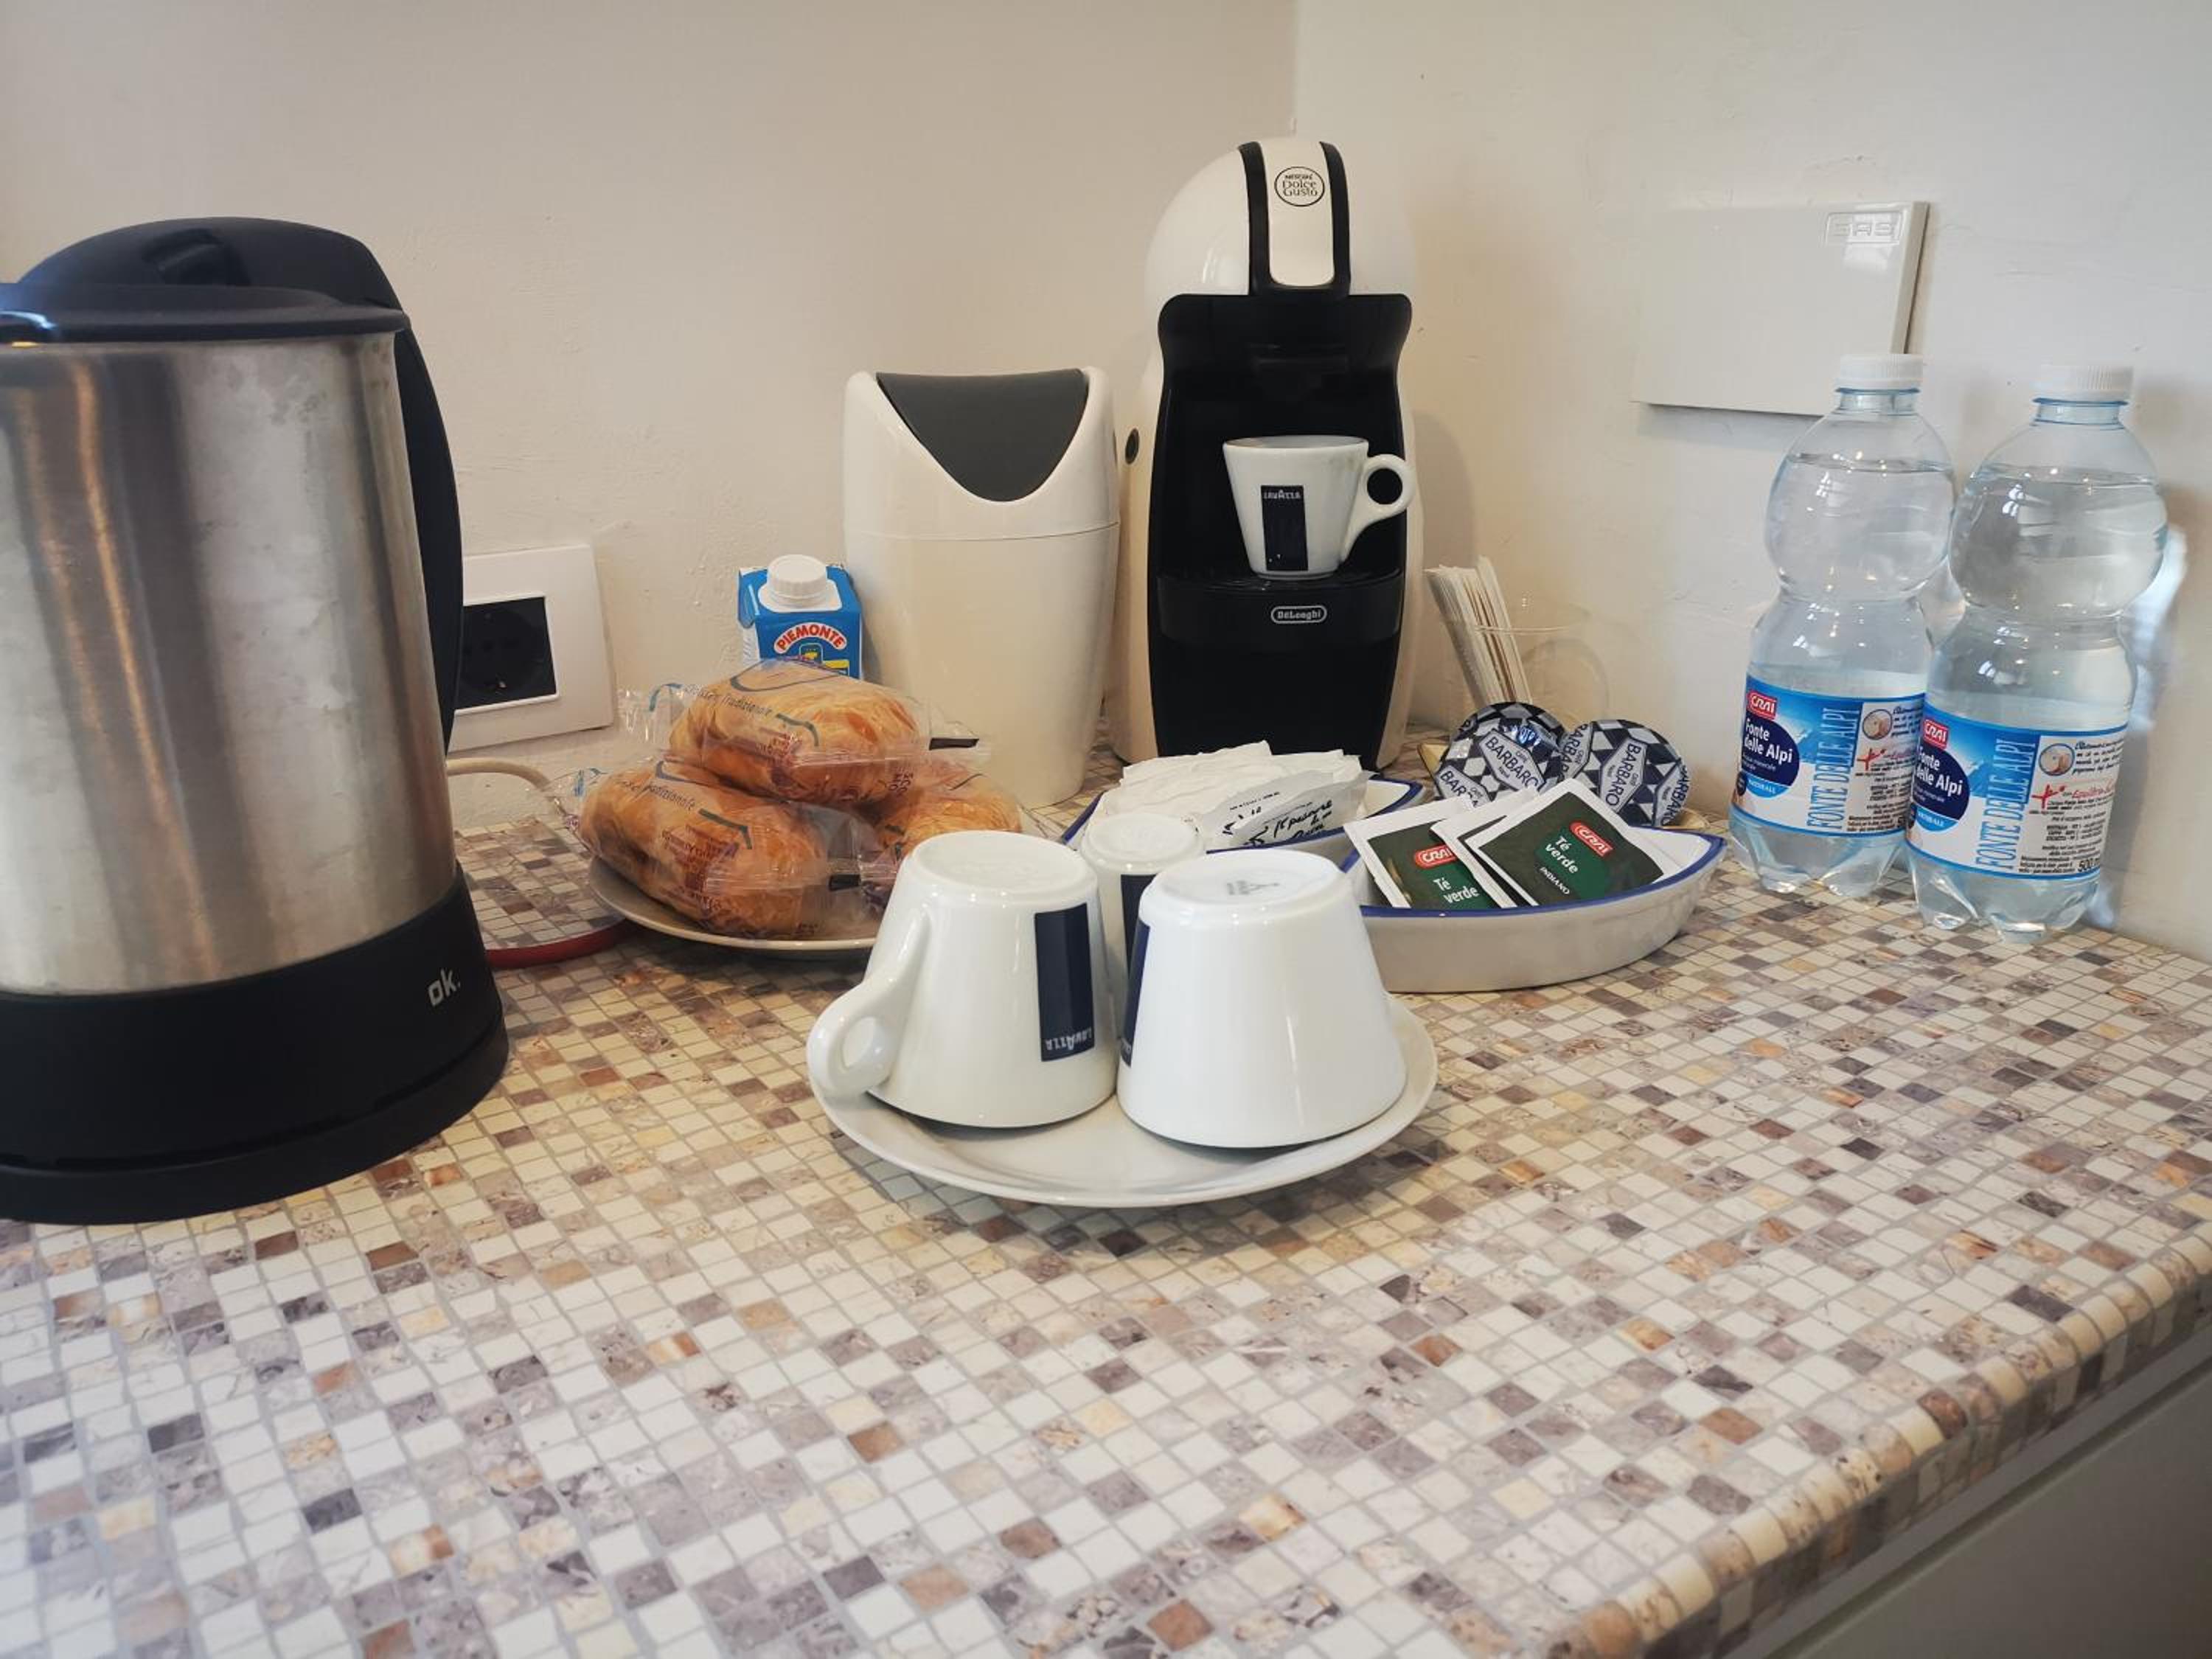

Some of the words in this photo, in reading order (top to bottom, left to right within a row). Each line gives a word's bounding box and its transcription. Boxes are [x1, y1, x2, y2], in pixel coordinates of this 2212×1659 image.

[1282, 178, 1316, 189] Dolce
[1282, 187, 1318, 196] Gusto
[1263, 490, 1301, 499] LAVAZZA
[776, 624, 846, 651] PIEMONTE
[1750, 693, 1775, 714] CRAI
[1820, 707, 1861, 740] ALPI
[1924, 722, 1947, 742] CRAI
[1766, 743, 1793, 765] Alpi
[1814, 740, 1855, 785] DELLE
[1992, 738, 2036, 775] ALPI
[1606, 743, 1642, 806] BARBARO
[1936, 774, 1964, 797] Alpi
[1807, 786, 1848, 830] FONTE
[1983, 774, 2030, 821] DELLE
[1556, 835, 1571, 852] Té
[1576, 827, 1612, 853] CRAI
[1976, 821, 2021, 869] FONTE
[1422, 844, 1453, 863] CRAI
[1545, 843, 1579, 874] verde
[1433, 877, 1451, 891] Té
[1444, 886, 1479, 904] verde
[428, 967, 462, 1007] ok.
[1045, 1027, 1093, 1051] LAVAZZA
